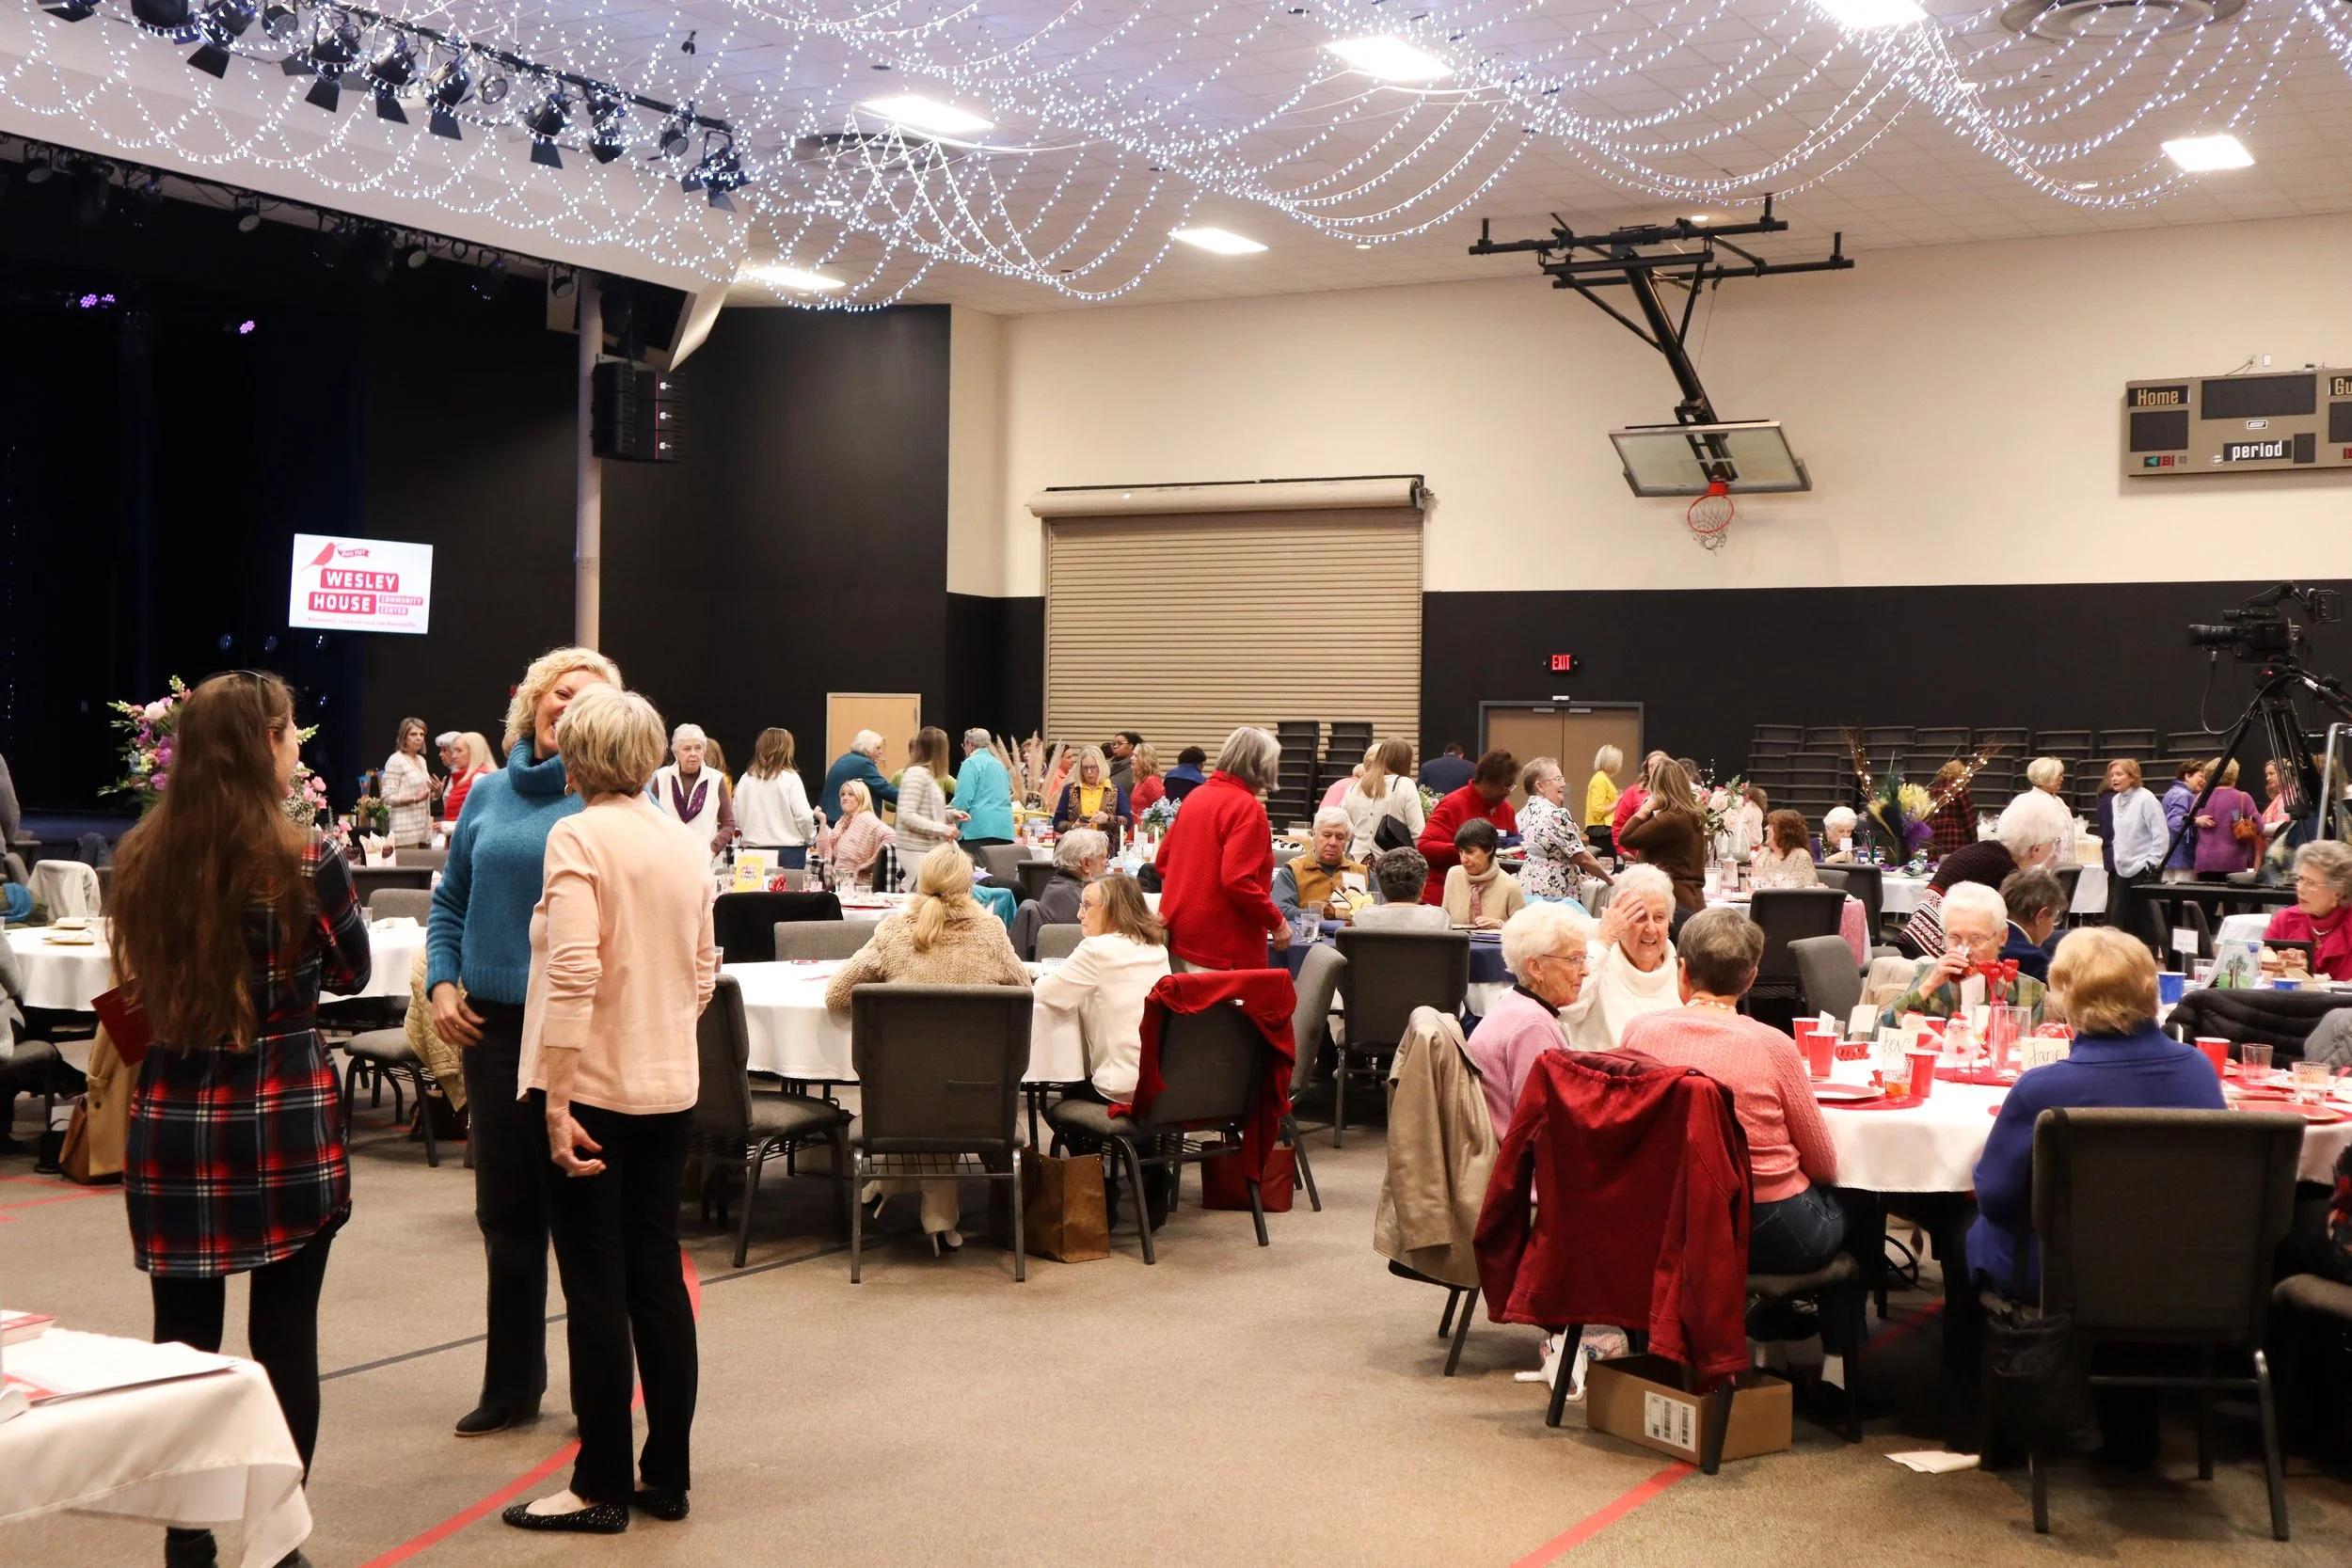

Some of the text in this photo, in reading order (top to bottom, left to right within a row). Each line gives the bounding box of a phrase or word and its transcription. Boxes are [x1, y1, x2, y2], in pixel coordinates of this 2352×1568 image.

[2137, 388, 2179, 406] Home
[2232, 440, 2282, 461] period
[326, 571, 396, 591] WESLEY
[313, 594, 371, 611] HOUSE
[381, 595, 422, 605] COMMUNITY
[1552, 655, 1571, 671] EXIT
[2028, 1040, 2061, 1067] Jane
